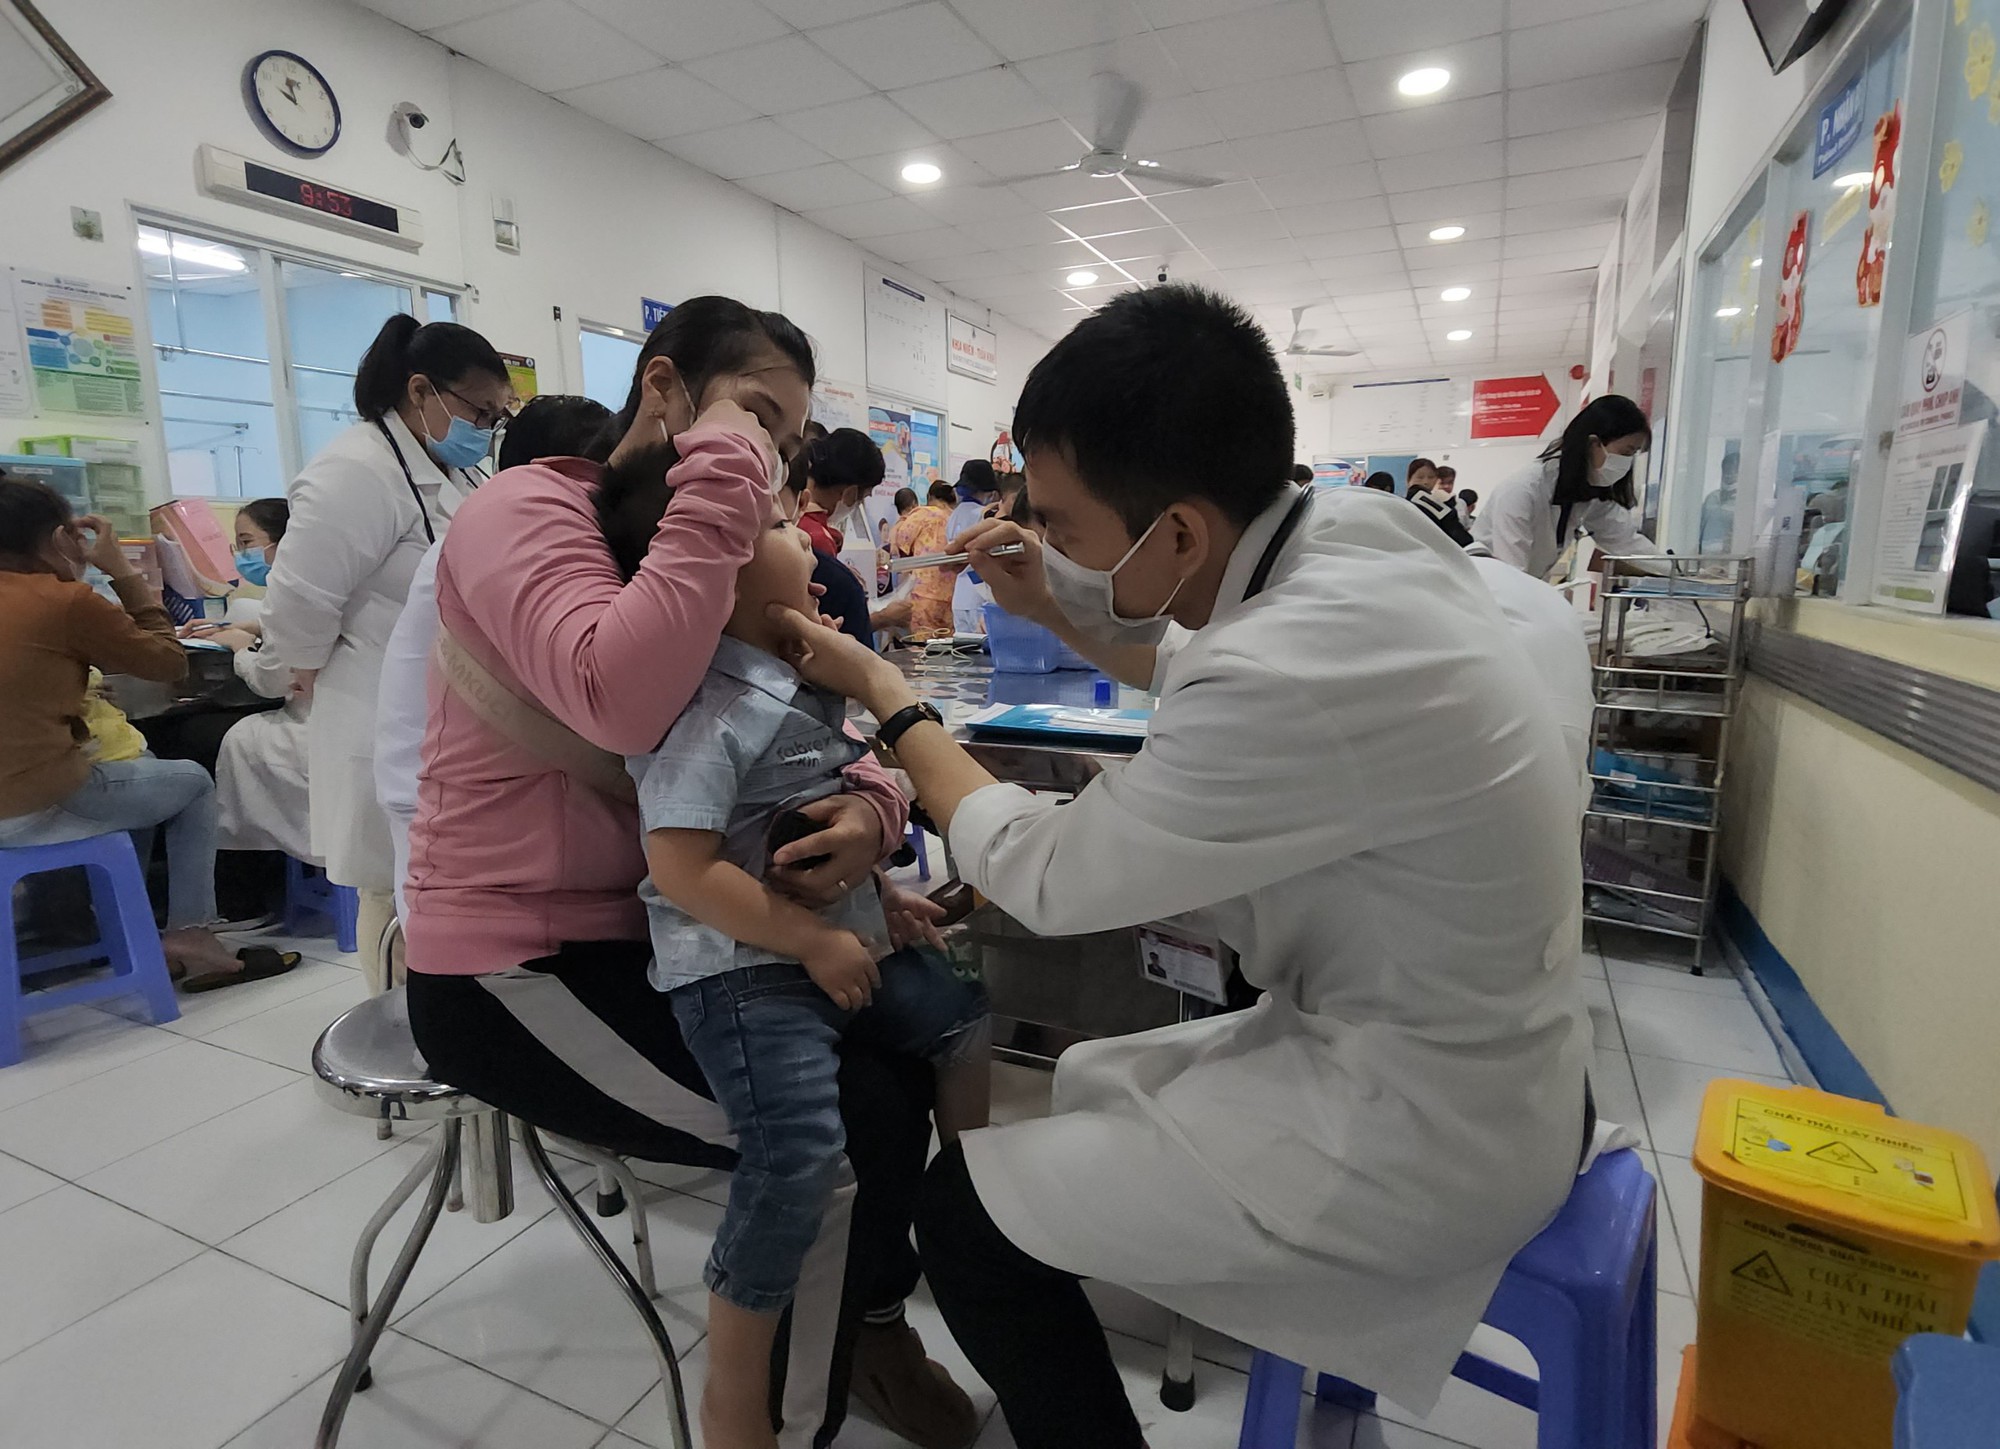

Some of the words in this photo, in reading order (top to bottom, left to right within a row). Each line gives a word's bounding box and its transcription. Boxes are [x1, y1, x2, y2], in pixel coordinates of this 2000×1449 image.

[300, 183, 352, 217] 9:53
[1804, 1289, 1850, 1316] LÂY
[1808, 1266, 1872, 1296] CHẤT
[1880, 1287, 1937, 1315] THẢI
